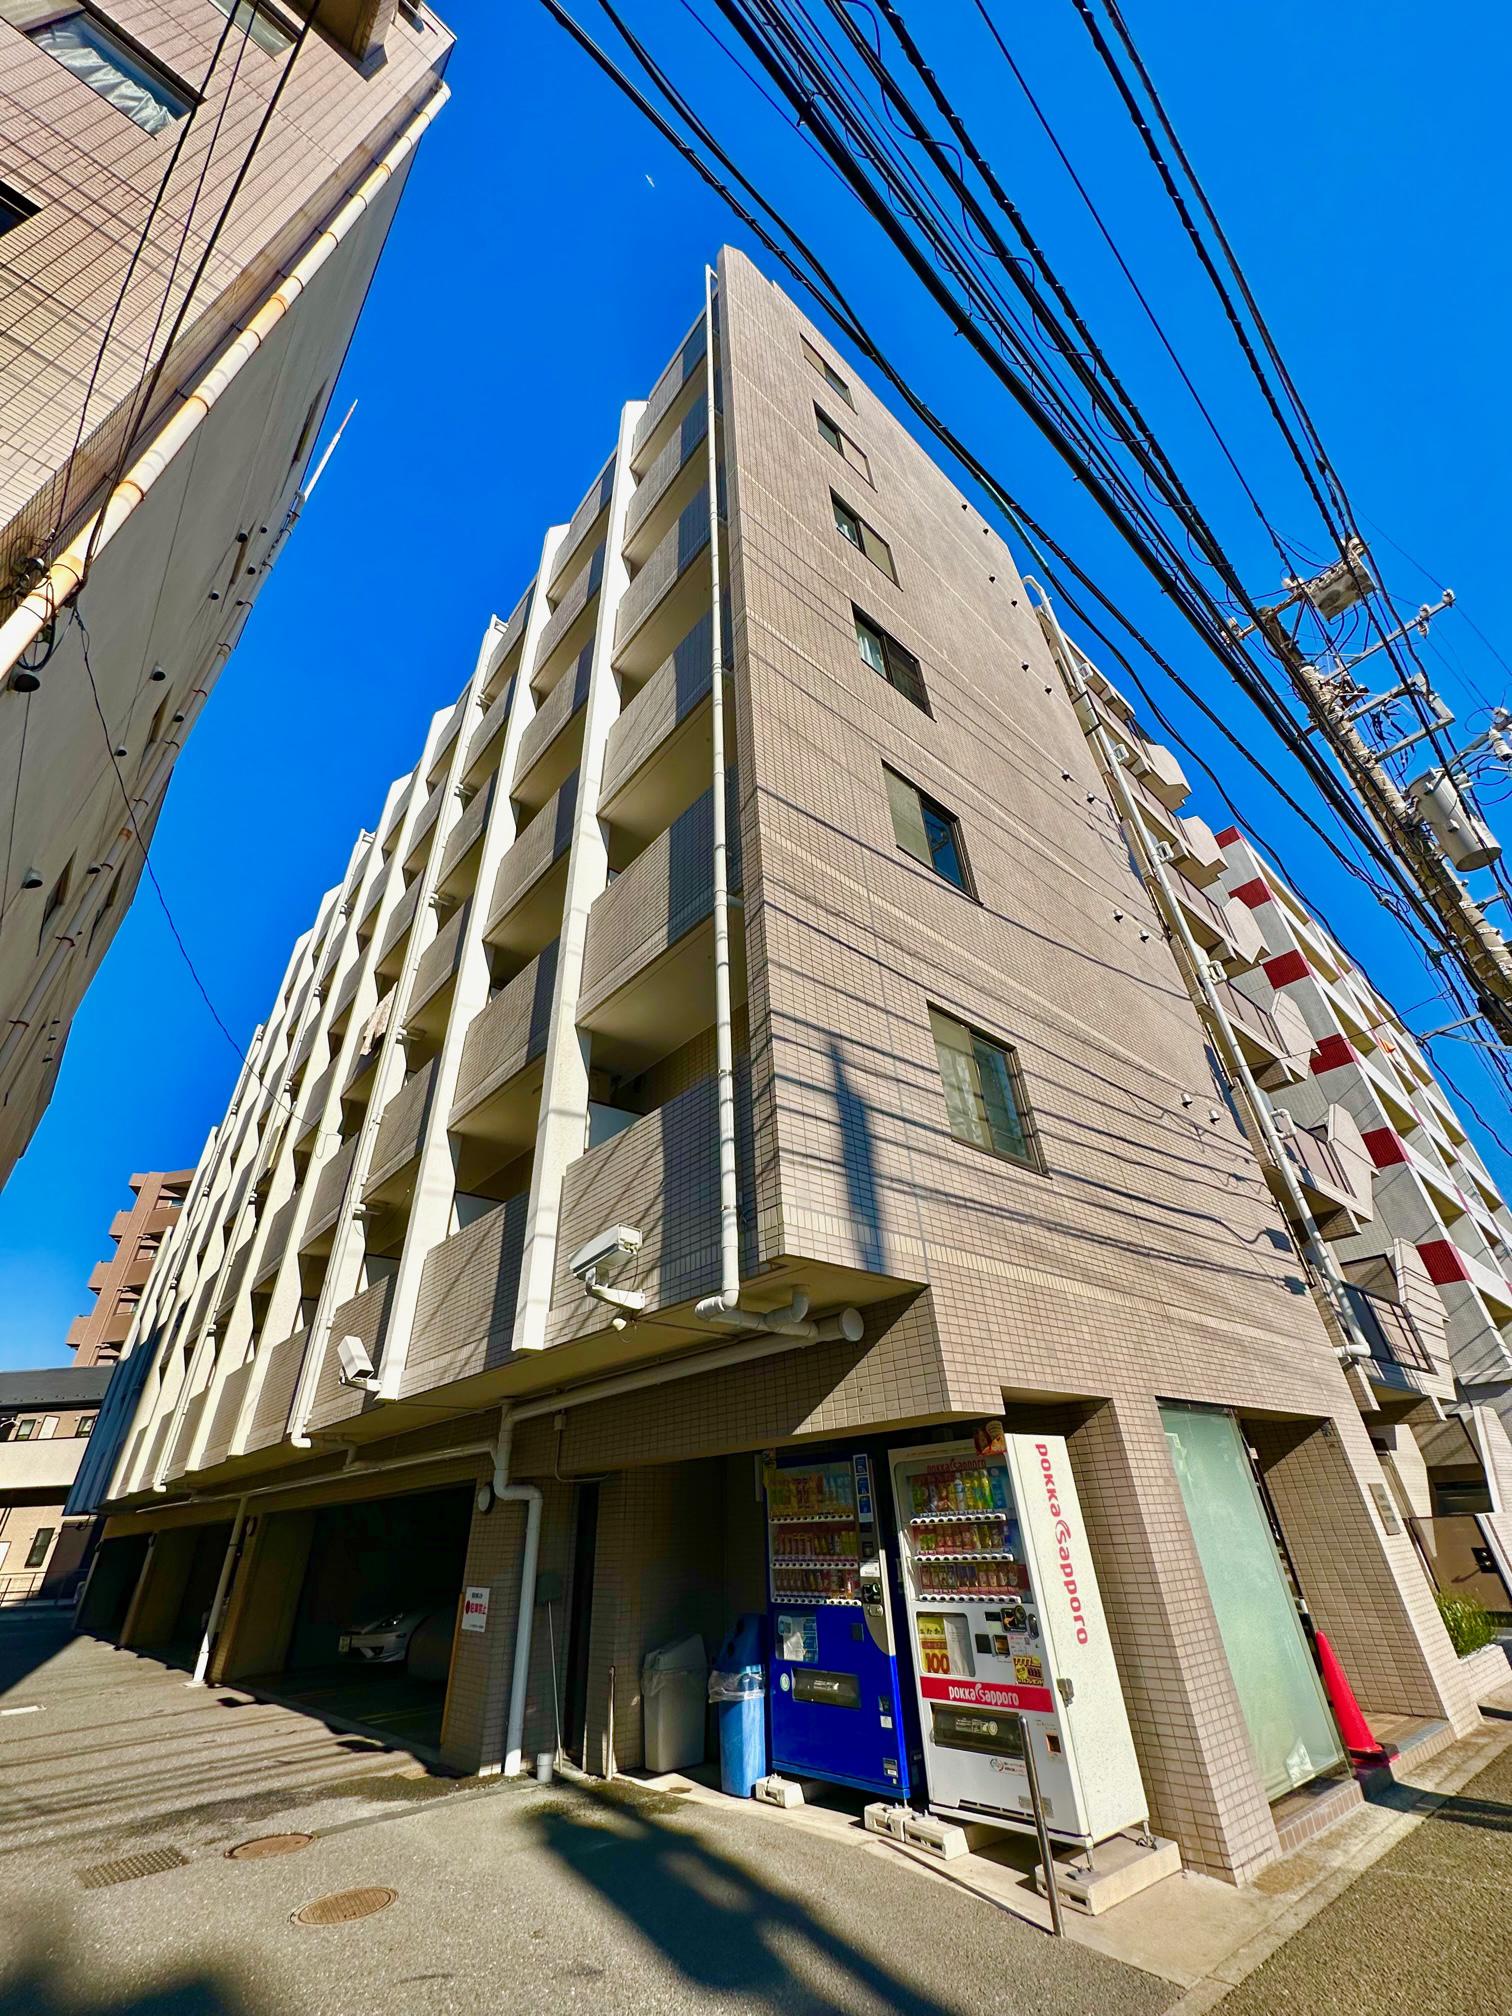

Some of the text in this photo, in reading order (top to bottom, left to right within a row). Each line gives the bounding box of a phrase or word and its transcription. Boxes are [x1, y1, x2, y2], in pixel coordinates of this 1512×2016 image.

[1035, 1443, 1089, 1645] pokka sapporo
[925, 1653, 950, 1674] 100
[948, 1686, 1020, 1706] pokka sapporo
